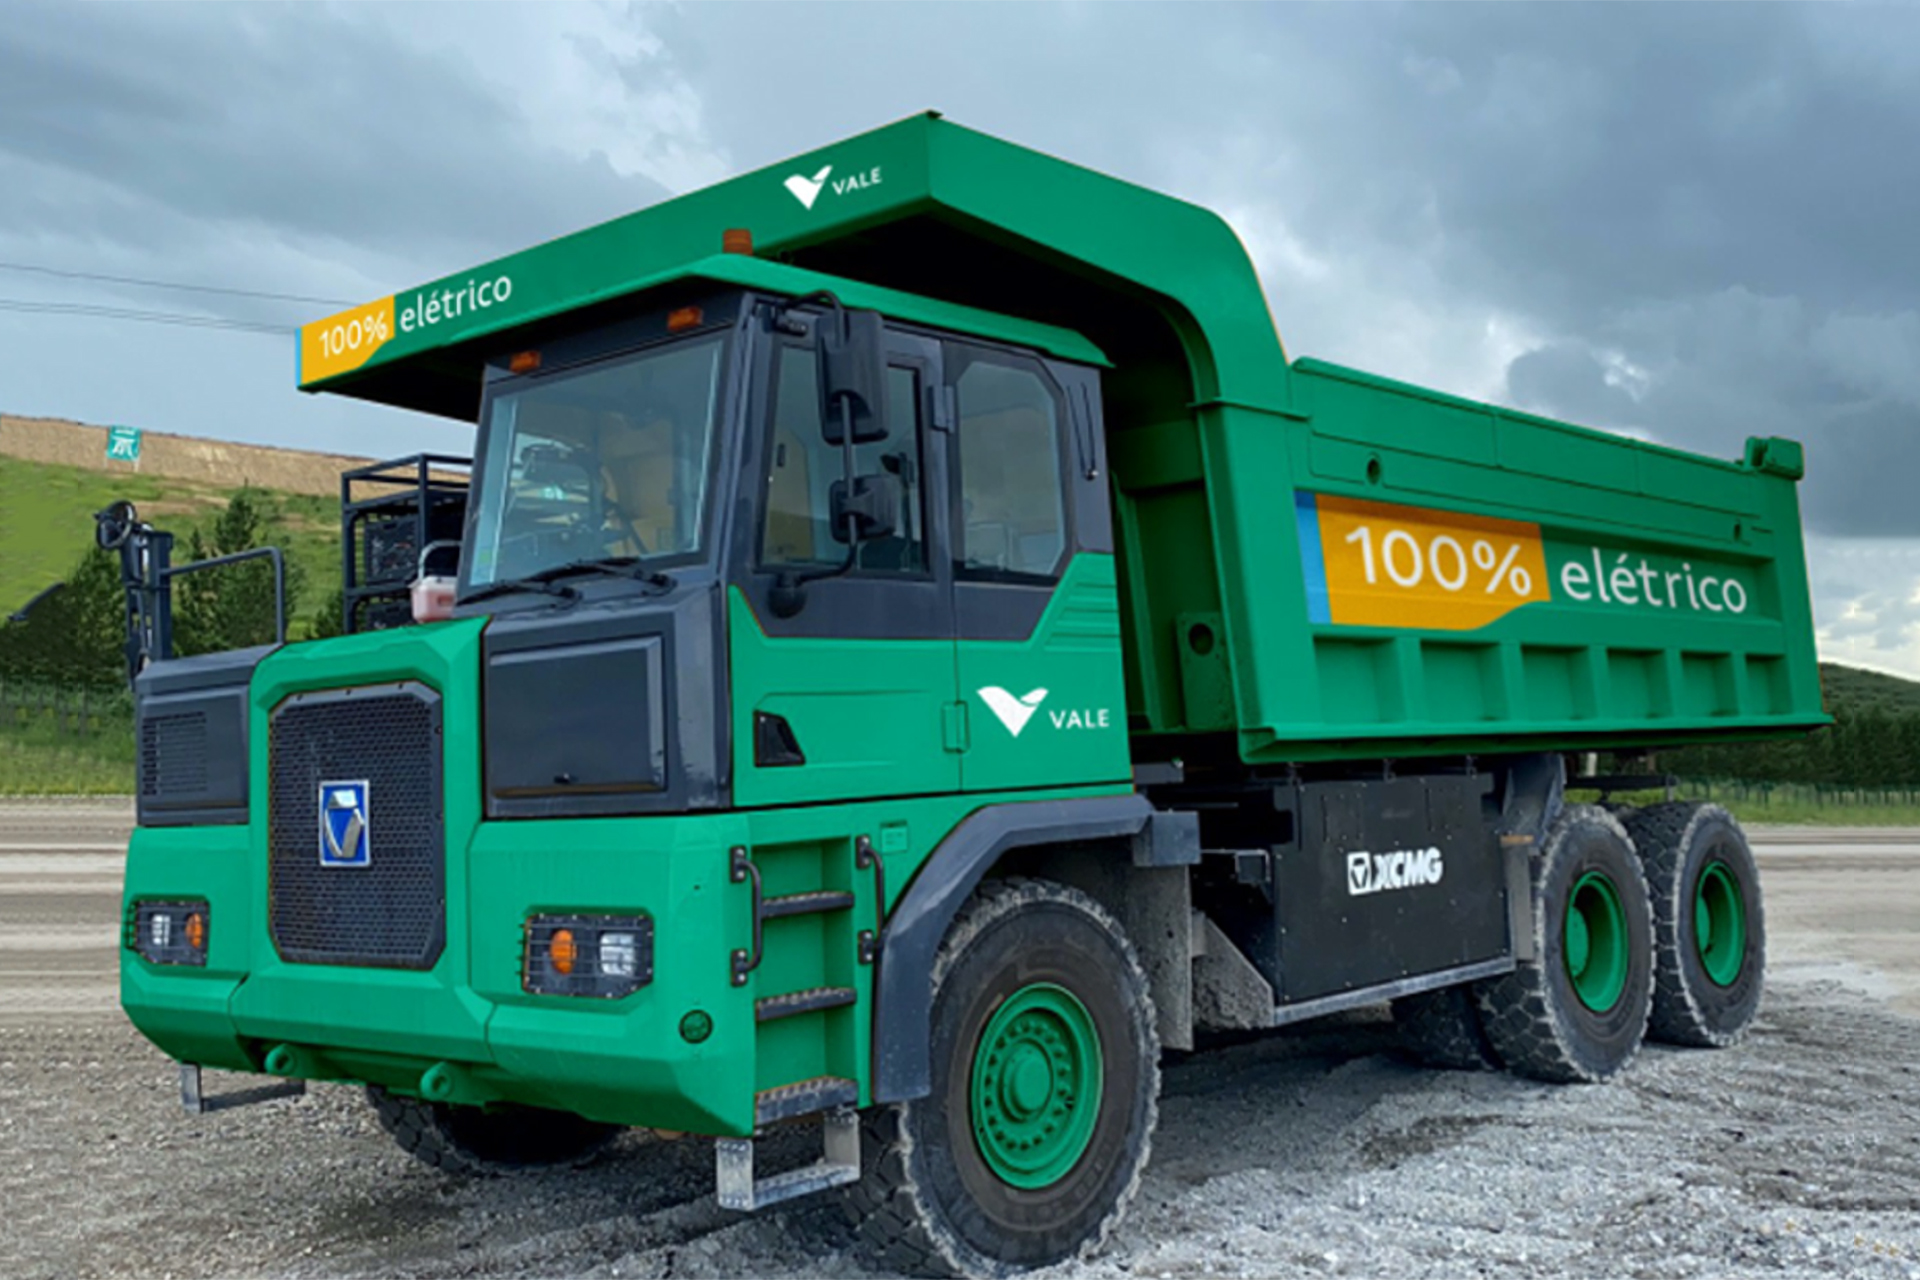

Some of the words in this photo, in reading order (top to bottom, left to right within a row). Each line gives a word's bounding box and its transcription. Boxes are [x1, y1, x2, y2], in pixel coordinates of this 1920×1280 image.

[832, 165, 882, 195] VALE
[319, 310, 389, 358] 100%
[400, 276, 512, 332] elétrico
[1345, 525, 1532, 597] 100%
[1560, 547, 1748, 613] elétrico
[1049, 709, 1110, 729] VALE
[1371, 847, 1443, 891] XCMG
